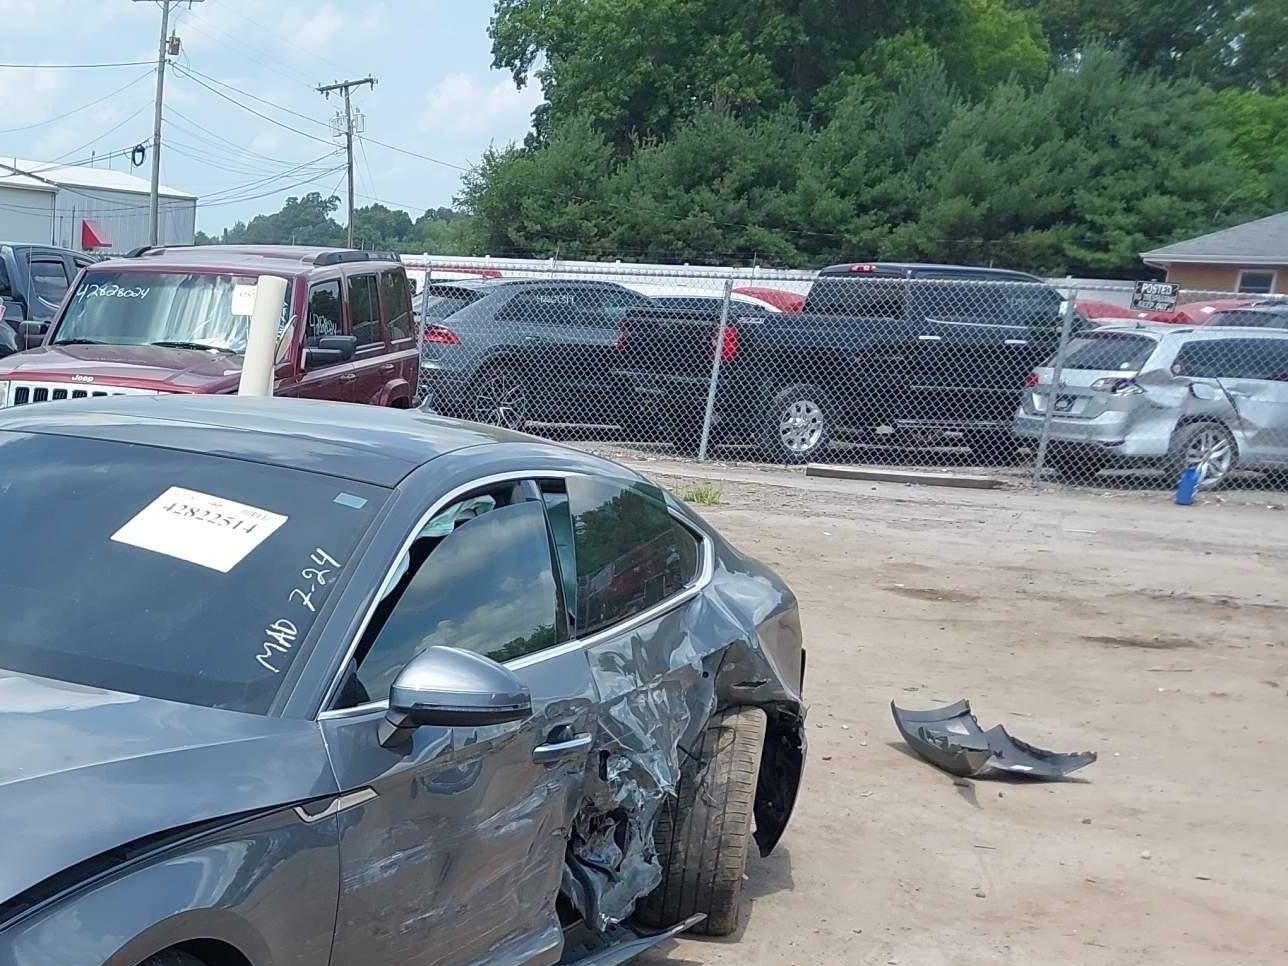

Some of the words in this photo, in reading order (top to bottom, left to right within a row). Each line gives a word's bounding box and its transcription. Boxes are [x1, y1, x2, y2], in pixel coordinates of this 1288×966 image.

[76, 283, 151, 304] 42828024
[1142, 282, 1173, 295] POSTED
[71, 374, 94, 383] Jeep
[162, 501, 258, 534] 42822514
[288, 547, 342, 612] 7-24
